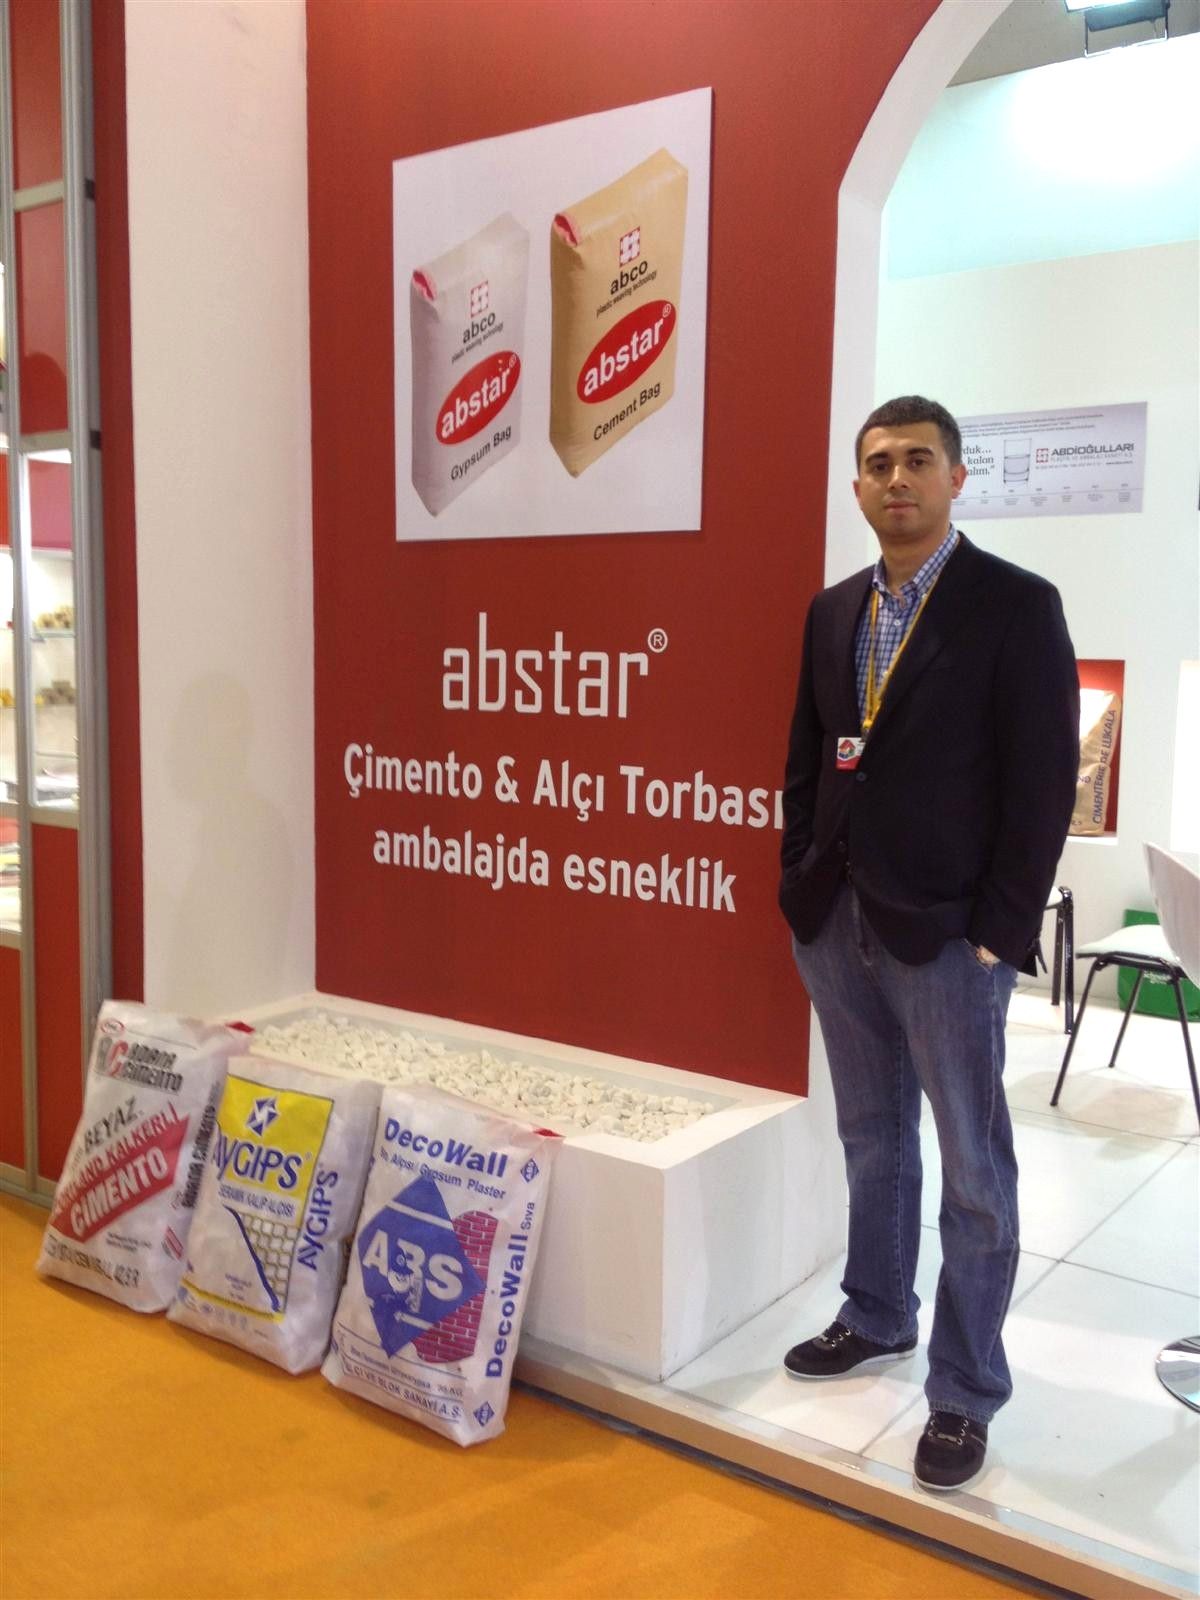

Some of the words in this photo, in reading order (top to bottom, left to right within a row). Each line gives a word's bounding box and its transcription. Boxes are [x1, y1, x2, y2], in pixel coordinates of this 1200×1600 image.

[610, 260, 648, 295] abco
[462, 312, 496, 344] abco
[593, 401, 637, 440] Cement
[639, 382, 661, 406] Bag
[450, 442, 490, 481] Gypsum
[493, 425, 512, 449] Bag
[1103, 709, 1117, 749] LUKALA
[344, 743, 482, 798] Çimento
[495, 755, 520, 803] &
[533, 759, 604, 822] Alçı
[619, 765, 784, 830] Torbası
[373, 825, 549, 890] ambalajda
[563, 853, 736, 914] esneklik
[84, 1096, 138, 1153] BEYAZ
[384, 1117, 508, 1178] DecoWall
[467, 1178, 507, 1200] Plaster
[485, 1233, 529, 1378] DecoWall
